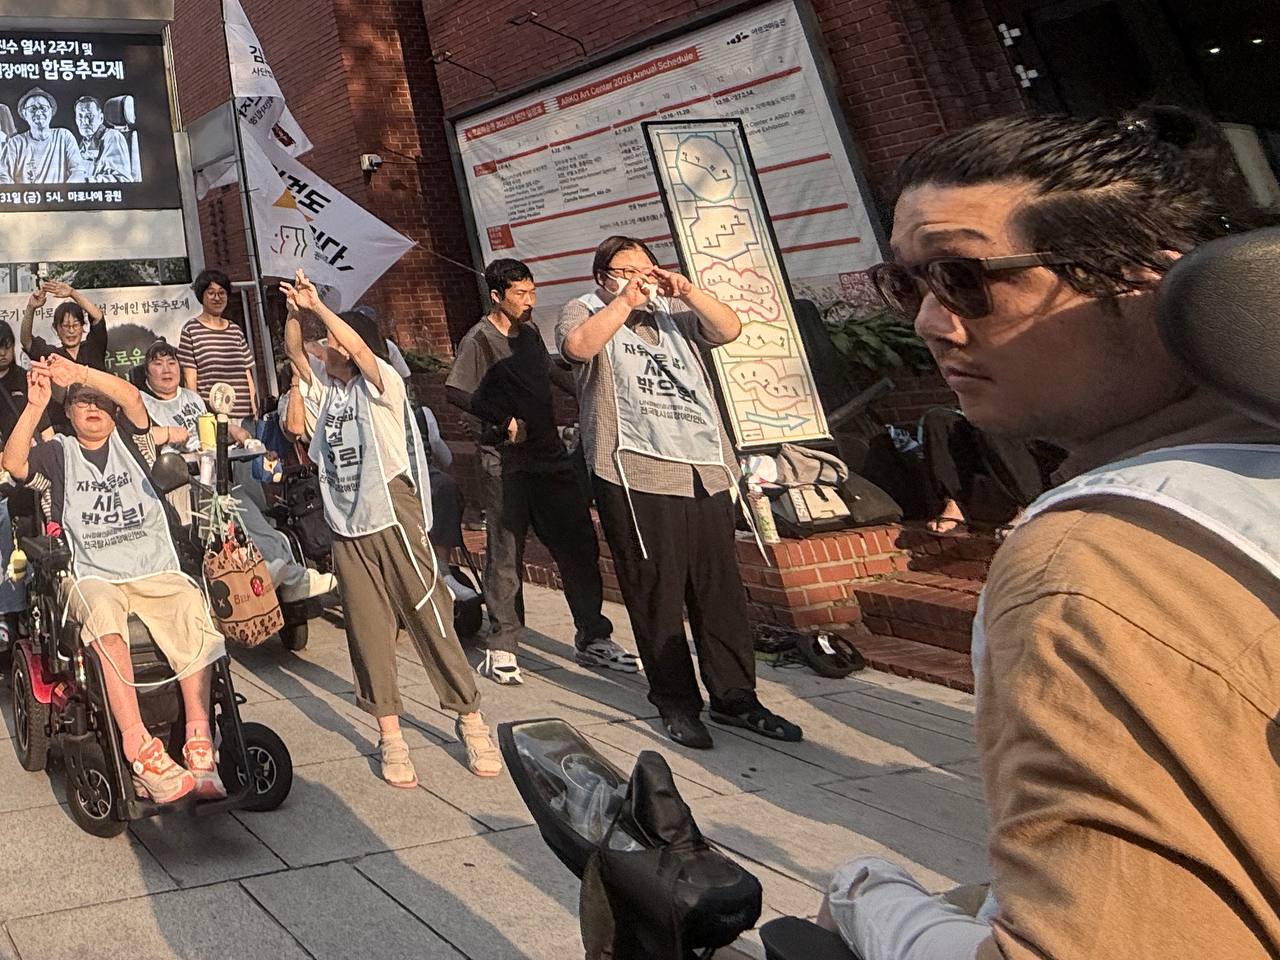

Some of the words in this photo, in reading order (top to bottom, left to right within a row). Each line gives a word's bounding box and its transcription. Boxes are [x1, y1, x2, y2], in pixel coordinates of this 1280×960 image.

[21, 39, 46, 55] 열사
[48, 40, 79, 55] 2주기
[81, 43, 93, 56] 및
[42, 59, 124, 80] 합동추모제
[560, 93, 580, 106] ARKO
[580, 90, 591, 100] Art
[591, 82, 613, 95] Center
[613, 73, 632, 86] 2026
[632, 64, 658, 80] Annual
[658, 52, 694, 71] Schedule
[0, 192, 21, 204] 31일
[23, 191, 41, 205] (금)
[67, 191, 103, 202] 마로니에
[105, 190, 122, 202] 공원
[110, 301, 139, 316] 장애인
[142, 297, 190, 314] 합동추모제
